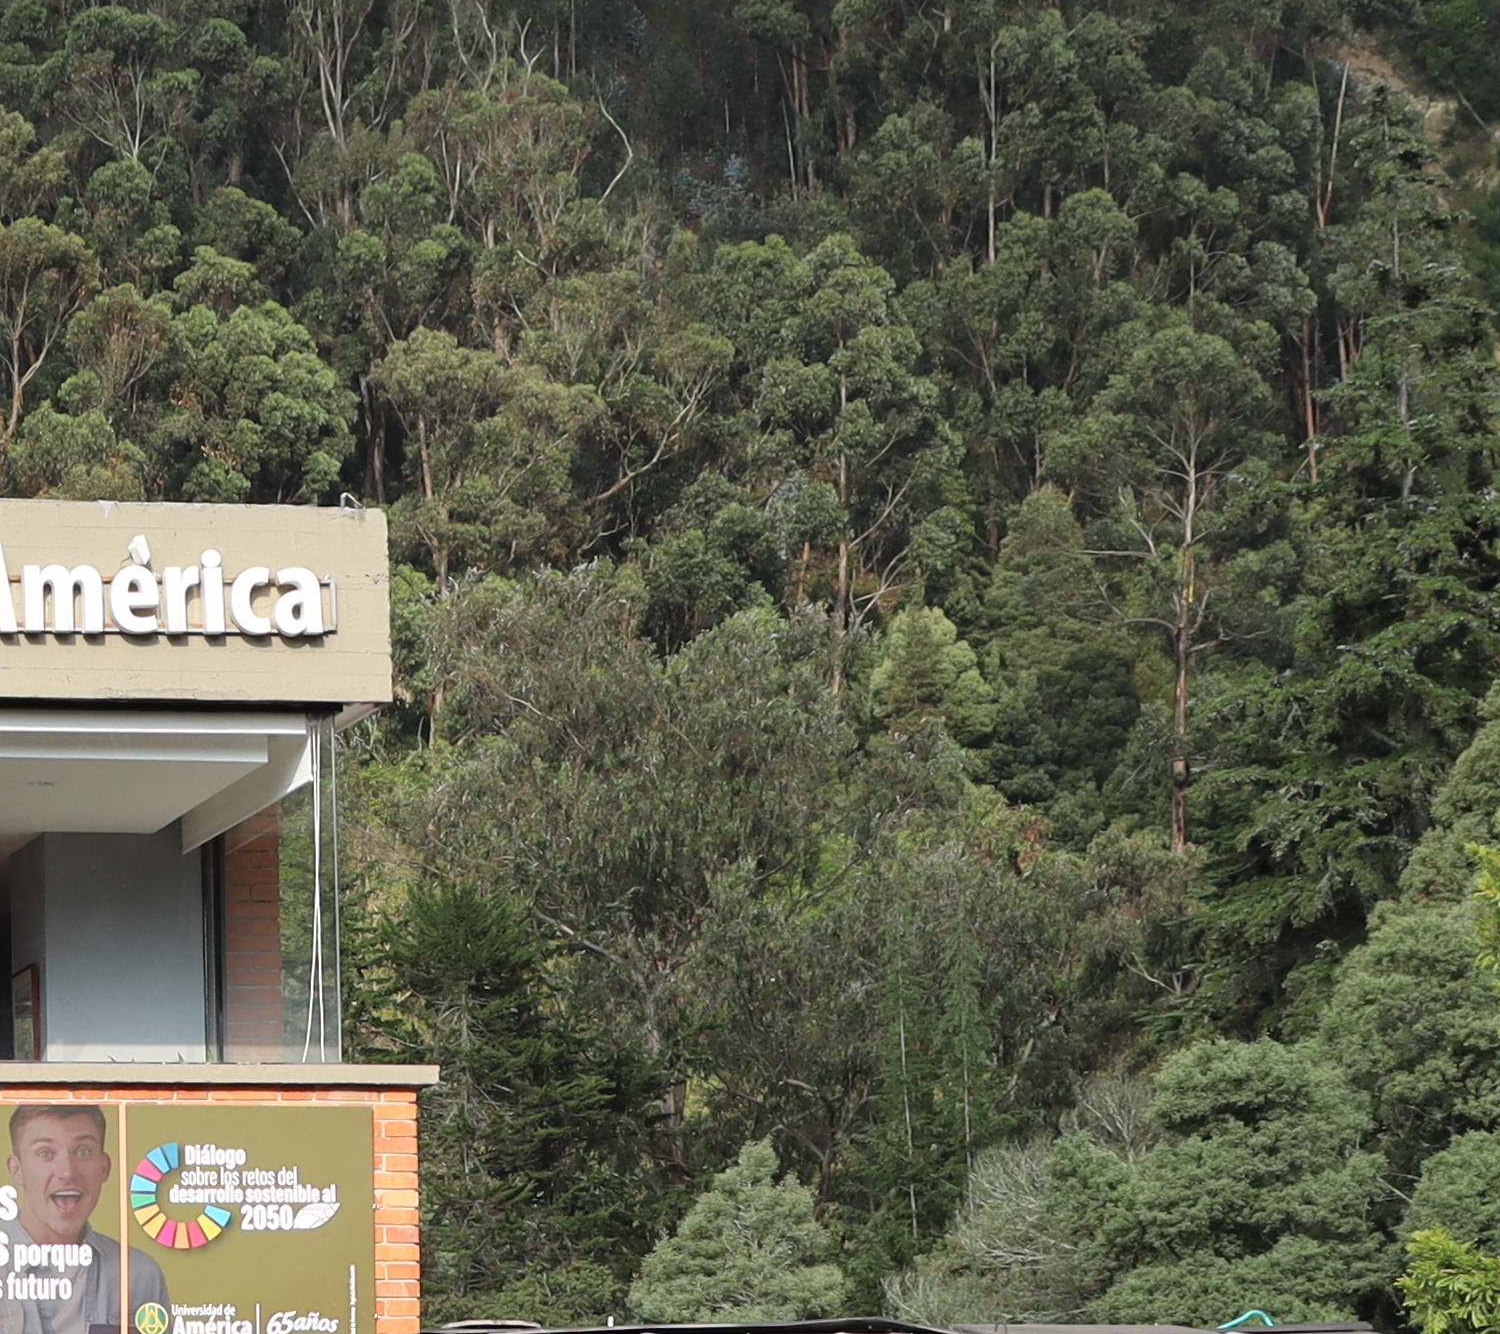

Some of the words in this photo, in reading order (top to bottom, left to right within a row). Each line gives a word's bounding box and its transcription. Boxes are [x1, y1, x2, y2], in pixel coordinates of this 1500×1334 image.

[184, 1144, 246, 1169] Diálogo
[181, 1166, 217, 1186] sobre
[220, 1167, 240, 1186] los
[242, 1169, 275, 1186] retos
[278, 1167, 298, 1185] del
[170, 1185, 242, 1203] desarrollo
[245, 1185, 320, 1203] sostenible
[322, 1184, 336, 1202] al
[241, 1204, 293, 1230] 2050
[14, 1244, 92, 1272] porque
[7, 1272, 71, 1300] futuro
[172, 1304, 221, 1316] Universidad
[224, 1304, 236, 1316] de
